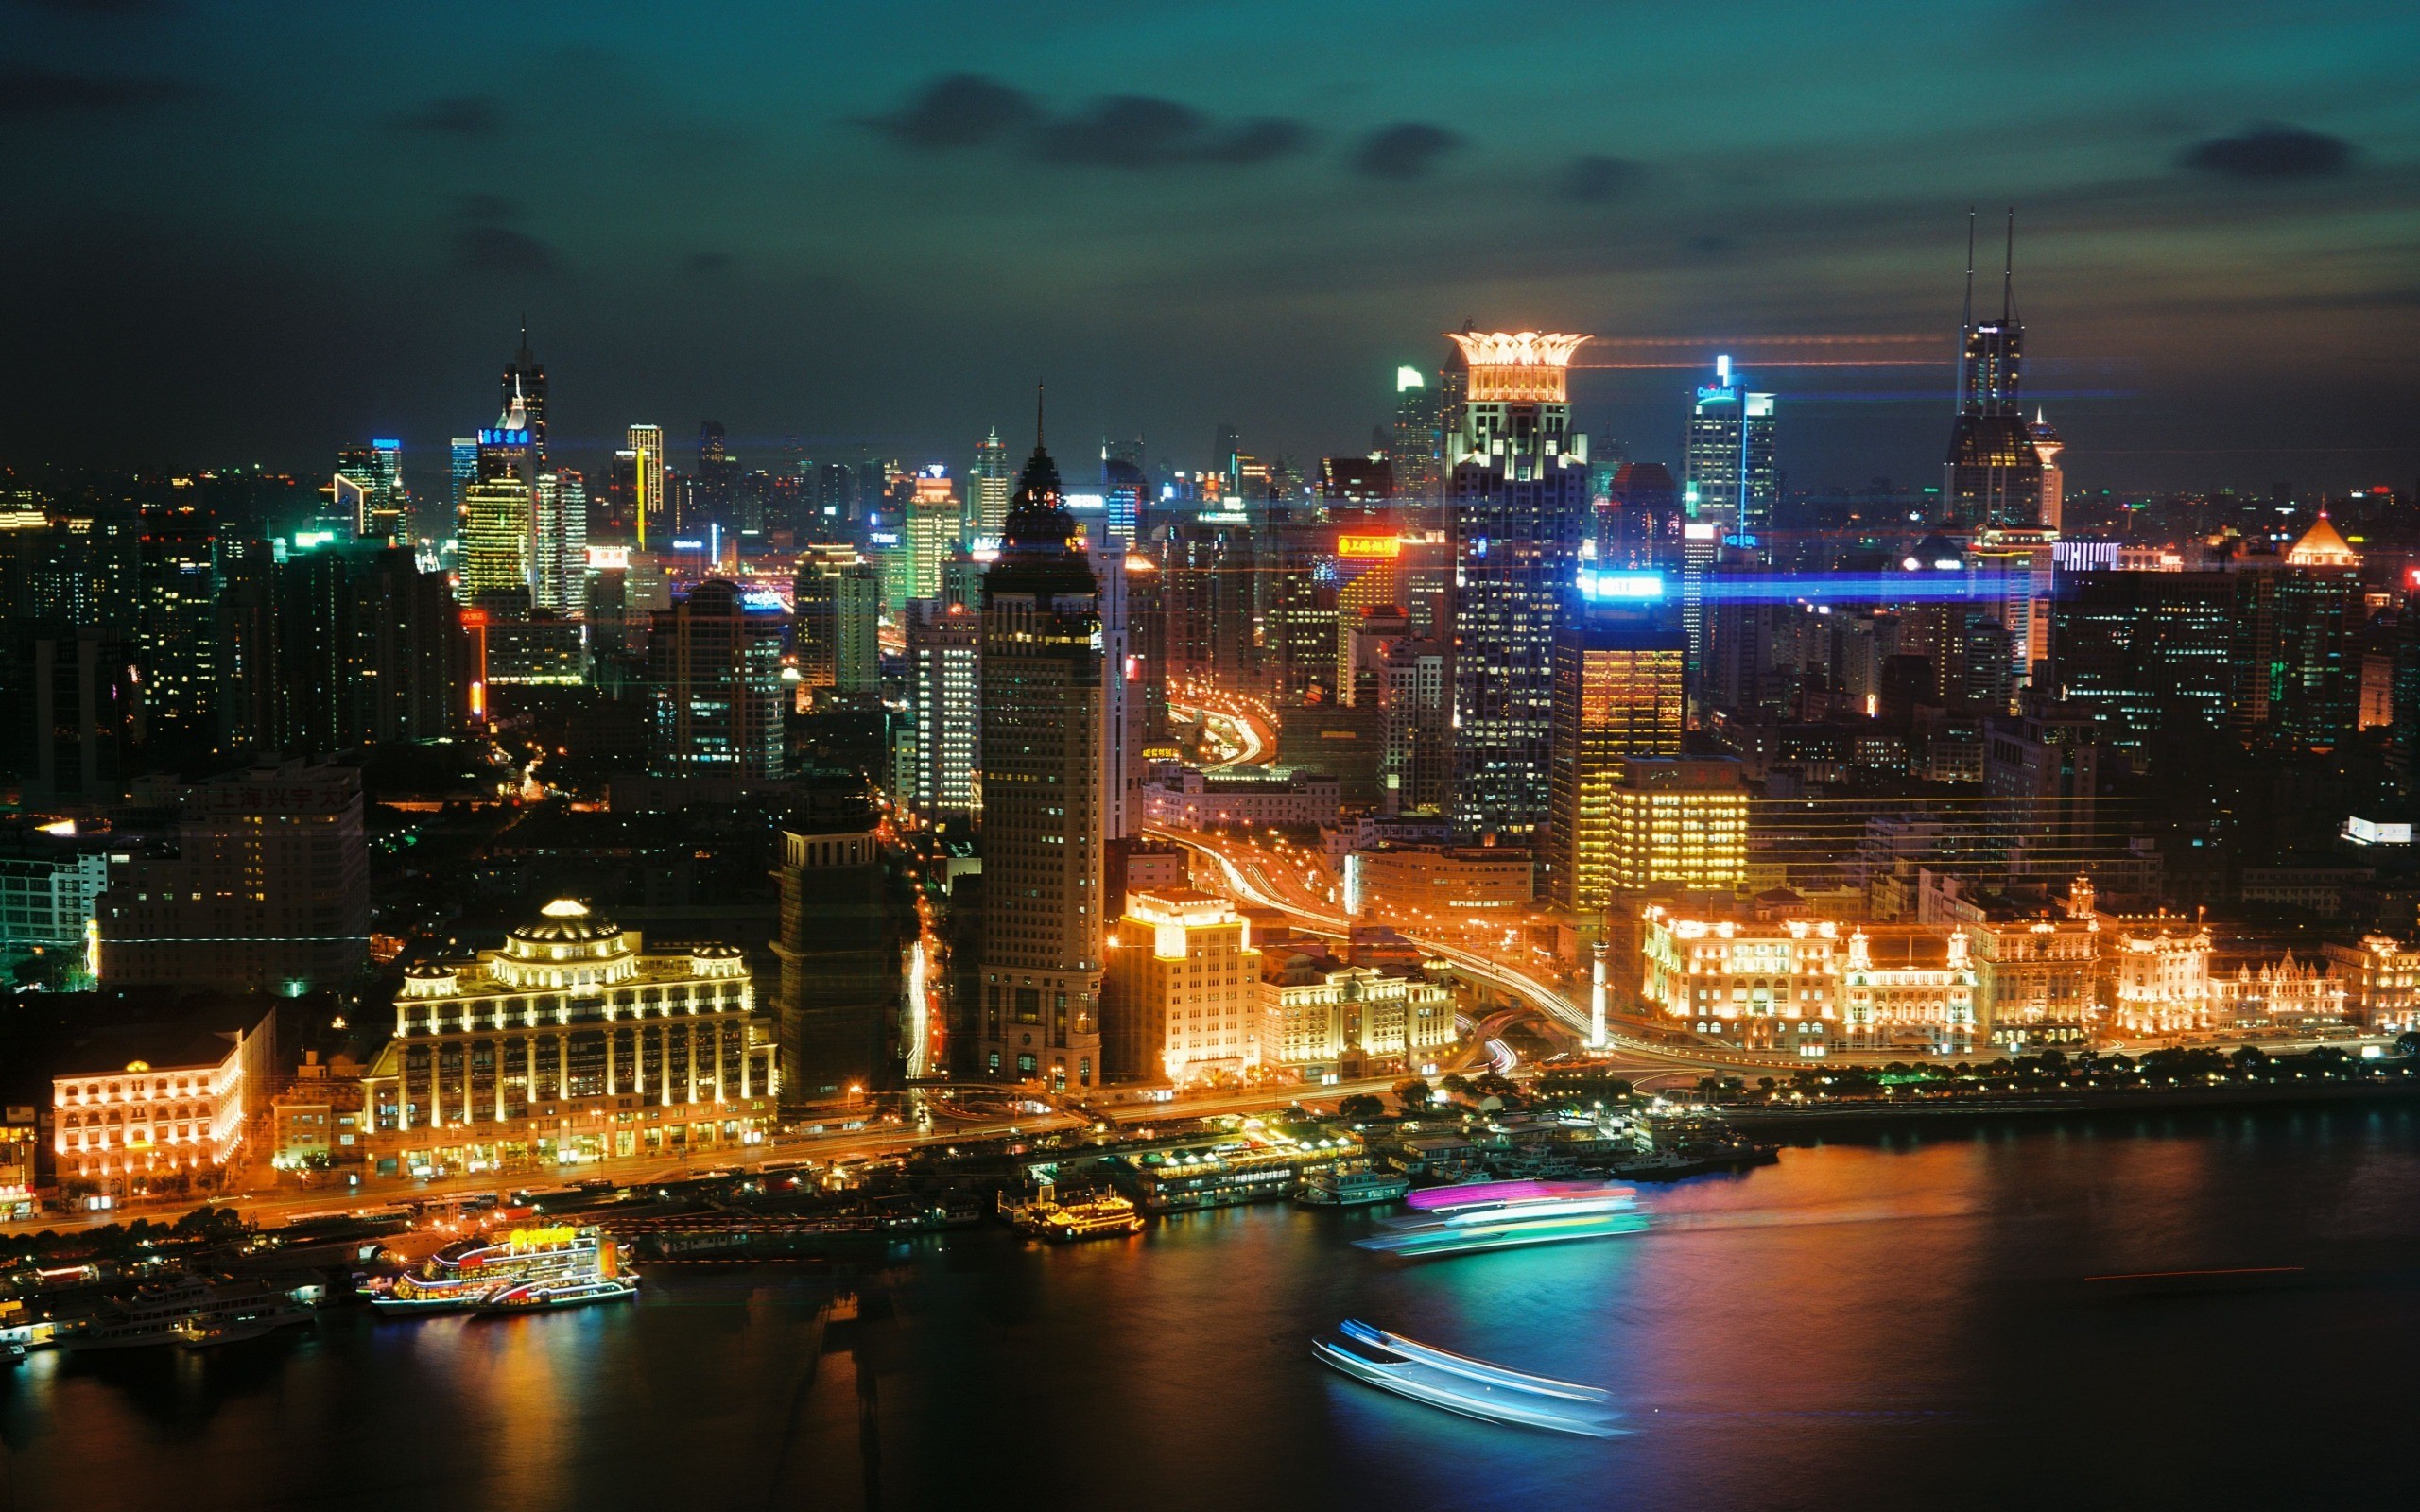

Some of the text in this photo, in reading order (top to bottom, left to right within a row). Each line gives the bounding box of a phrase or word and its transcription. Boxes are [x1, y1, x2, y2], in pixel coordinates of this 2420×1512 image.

[214, 786, 348, 809] 上海兴宇大
